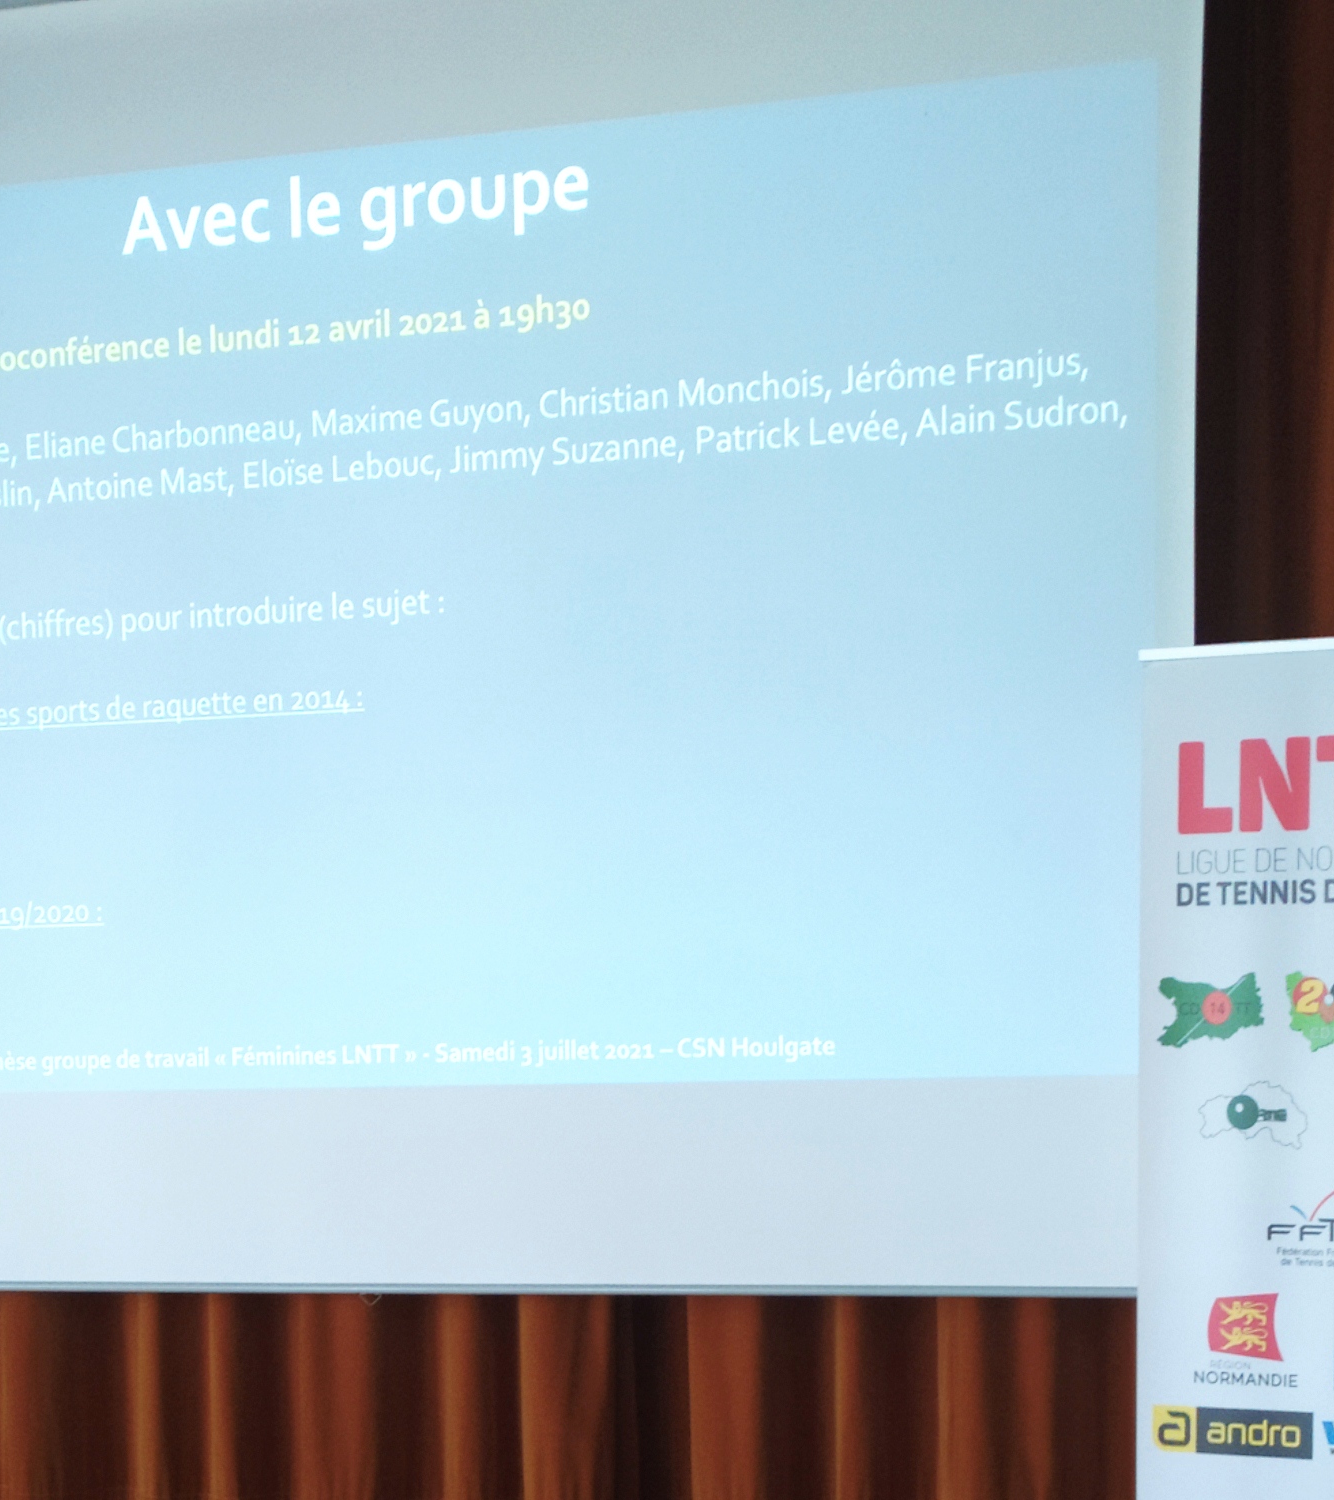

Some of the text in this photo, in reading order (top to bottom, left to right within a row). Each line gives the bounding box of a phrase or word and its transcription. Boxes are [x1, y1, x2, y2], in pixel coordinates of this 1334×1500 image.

[123, 166, 588, 255] Avec le groupe
[179, 327, 201, 356] le
[210, 318, 279, 353] lundi
[289, 323, 320, 346] 12
[329, 308, 390, 342] avril
[399, 310, 466, 336] 2021
[474, 299, 490, 330] à
[499, 293, 590, 333] 19h30
[26, 431, 105, 460] Eliane
[113, 419, 301, 453] Charbonneau,
[312, 405, 422, 437] Maxime
[430, 399, 530, 434] Guyon,
[540, 384, 668, 419] Christian
[679, 369, 831, 408] Monchois,
[842, 358, 955, 395] Jérôme
[967, 349, 1088, 388] Franjus,
[48, 472, 152, 503] Antoine
[161, 467, 233, 497] Mast,
[244, 459, 323, 489] Eloïse
[333, 451, 441, 483] Lebouc,
[450, 444, 545, 476] Jimmy
[552, 435, 684, 466] Suzanne,
[696, 418, 799, 454] Patrick
[810, 409, 907, 446] Levée,
[916, 404, 995, 437] Alain
[1004, 395, 1127, 431] Sudron,
[0, 608, 113, 645] (chiffres)
[121, 610, 182, 641] pour
[190, 596, 322, 629] introduire
[332, 591, 354, 620] le
[363, 589, 430, 625] sujet
[27, 700, 100, 731] sports
[106, 695, 135, 726] de
[143, 692, 246, 724] raquette
[253, 693, 282, 717] en
[292, 690, 350, 716] 2014
[1176, 849, 1246, 875] LIGUE
[1255, 847, 1287, 873] DE
[1176, 882, 1211, 907] DE
[1216, 879, 1316, 906] TENNIS
[42, 1054, 110, 1076] groupe
[117, 1049, 139, 1069] de
[145, 1046, 209, 1069] travail
[232, 1045, 336, 1066] Féminines
[342, 1043, 399, 1065] LNTT
[435, 1041, 515, 1063] Samedi
[521, 1045, 532, 1067] 3
[536, 1039, 599, 1067] juillet
[605, 1043, 654, 1060] 2021
[677, 1037, 725, 1058] CSN
[732, 1035, 835, 1063] Houlgate
[1193, 1371, 1298, 1388] NORMANDIE
[1206, 1418, 1301, 1448] andro
